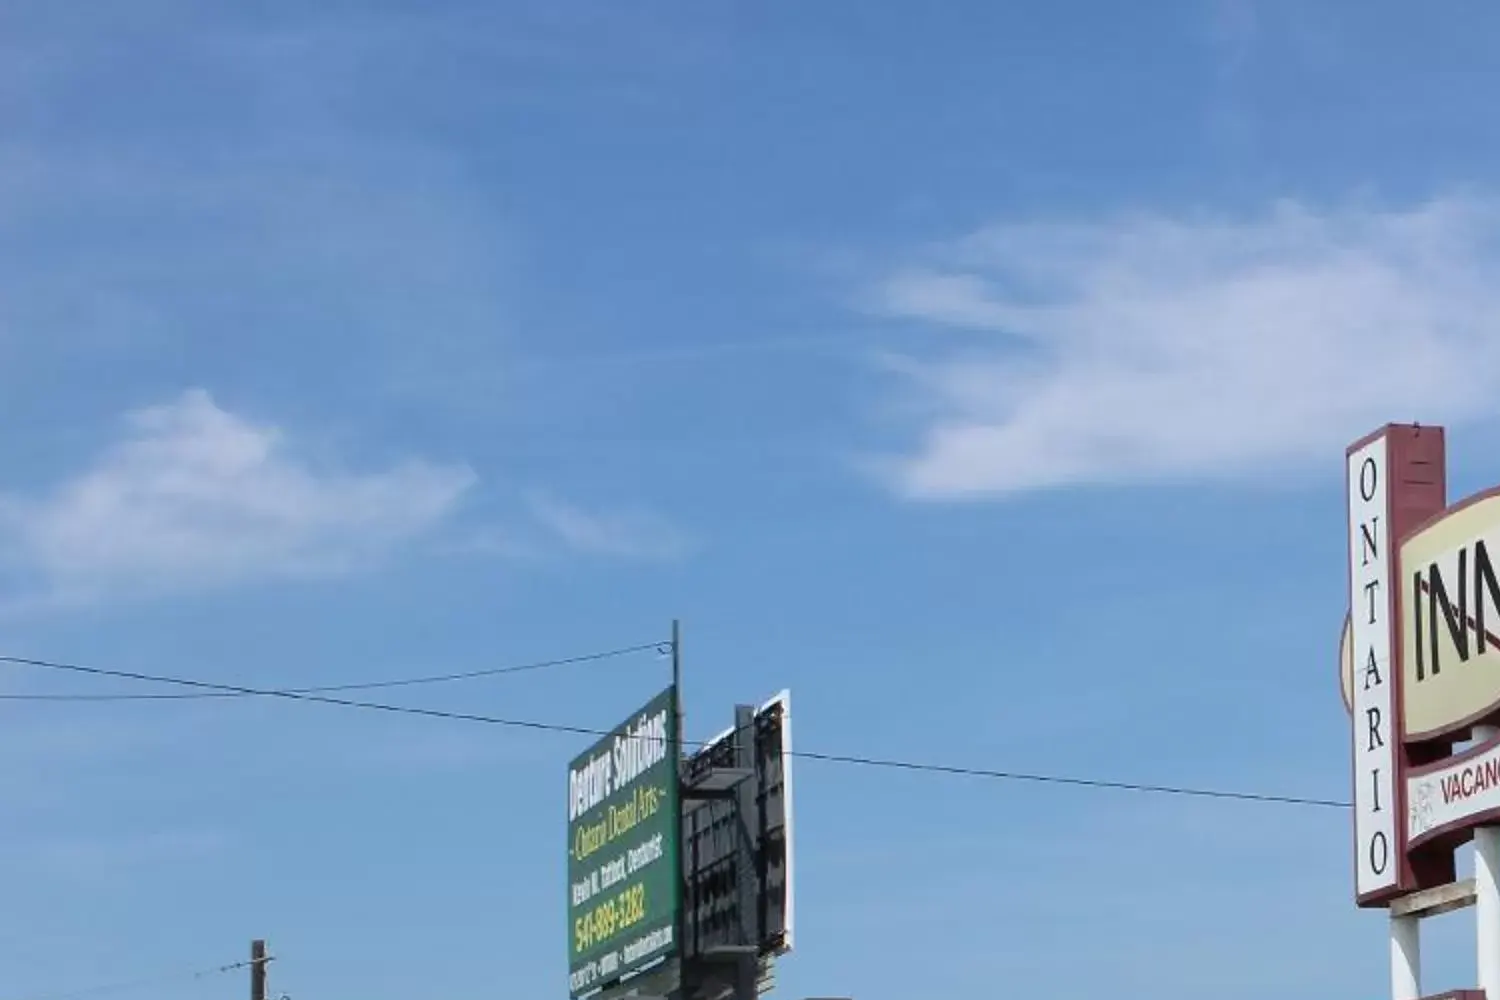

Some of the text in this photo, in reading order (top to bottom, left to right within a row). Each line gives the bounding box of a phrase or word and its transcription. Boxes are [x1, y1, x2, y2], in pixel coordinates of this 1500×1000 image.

[1360, 457, 1388, 875] ONTARIO
[570, 709, 667, 822] Denture Solutions
[608, 789, 637, 841] Dental
[638, 786, 658, 822] Arts
